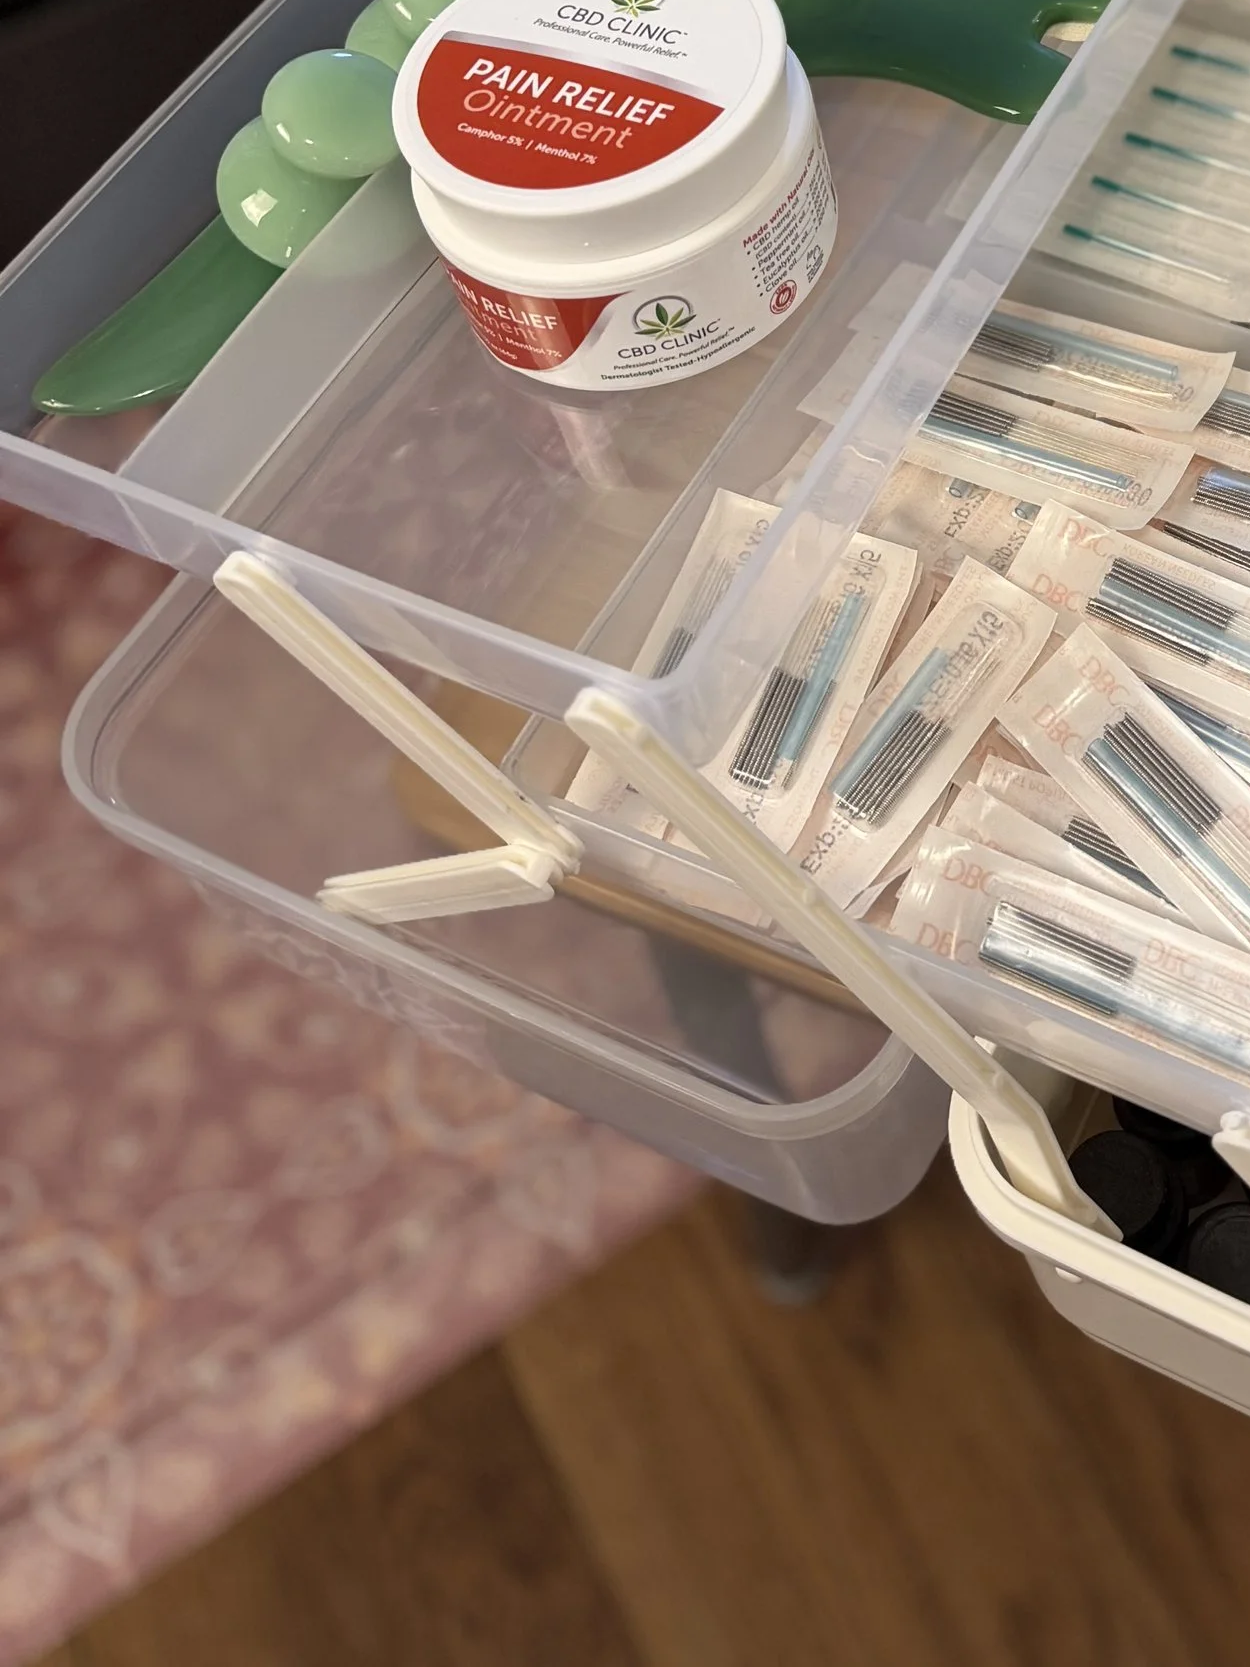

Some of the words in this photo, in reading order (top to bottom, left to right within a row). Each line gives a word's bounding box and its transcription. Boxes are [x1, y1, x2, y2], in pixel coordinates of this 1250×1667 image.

[557, 5, 604, 26] CBD
[533, 18, 590, 37] Professional
[588, 32, 611, 43] Care.
[612, 37, 654, 53] Powerful
[463, 58, 553, 99] PAIN
[552, 81, 675, 126] RELIEF
[463, 89, 632, 149] Ointment
[457, 122, 505, 142] Camphor
[506, 135, 524, 147] 5%
[535, 142, 580, 161] Menthol
[579, 153, 598, 165] 7%
[742, 223, 769, 248] Made
[769, 203, 788, 226] with
[787, 166, 808, 202] Natural
[752, 232, 771, 251] CBD
[771, 212, 791, 234] hemp
[791, 196, 800, 211] oil
[758, 225, 798, 268] Peppermint
[760, 261, 775, 276] Tea
[776, 245, 791, 264] tree
[763, 245, 801, 284] Eucalyptus
[766, 271, 787, 292] Clove
[481, 296, 558, 330] RELIEF
[613, 359, 658, 371] Professional
[658, 355, 677, 364] Care.
[678, 342, 710, 359] Powerful
[618, 344, 656, 359] CBD
[601, 367, 663, 380] Dermatologist
